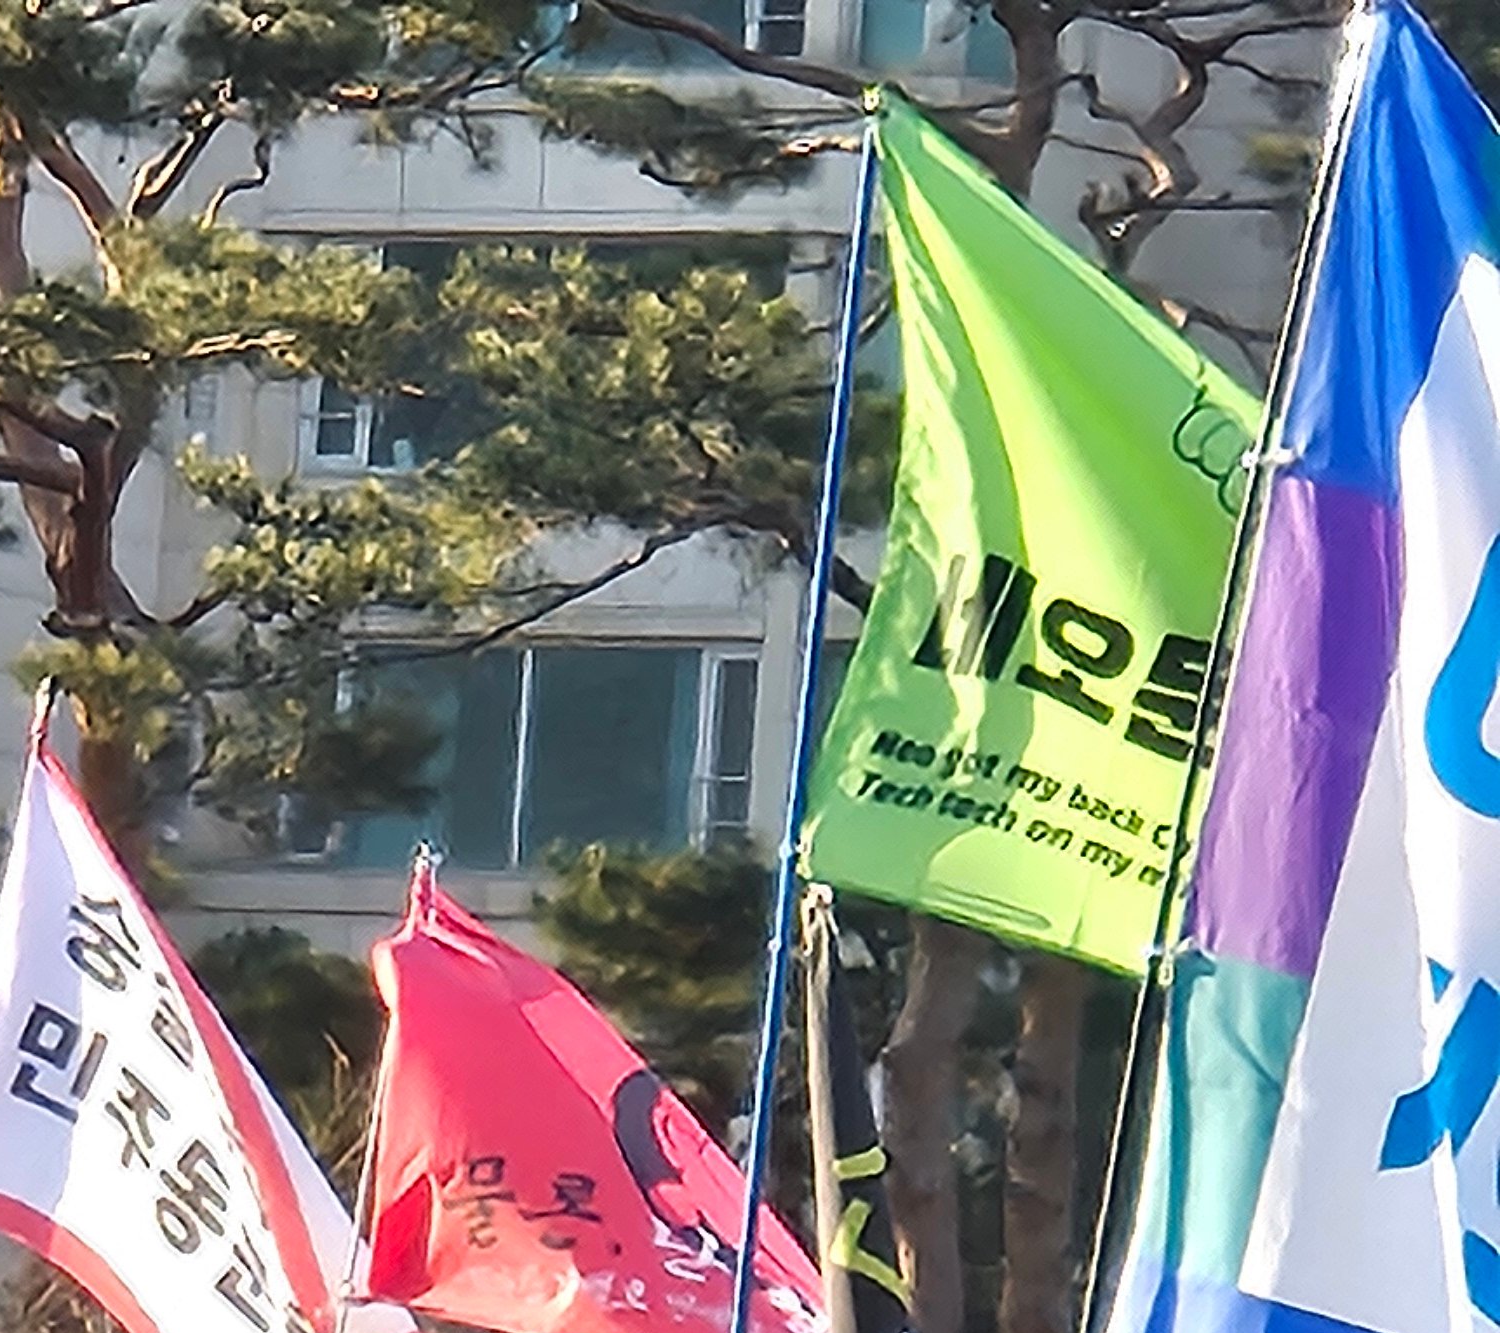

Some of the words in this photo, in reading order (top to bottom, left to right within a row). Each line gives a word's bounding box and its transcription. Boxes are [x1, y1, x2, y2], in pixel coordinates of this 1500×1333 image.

[1005, 764, 1062, 802] my
[1068, 783, 1145, 836] back
[1025, 820, 1074, 851] on
[1080, 840, 1134, 878] my
